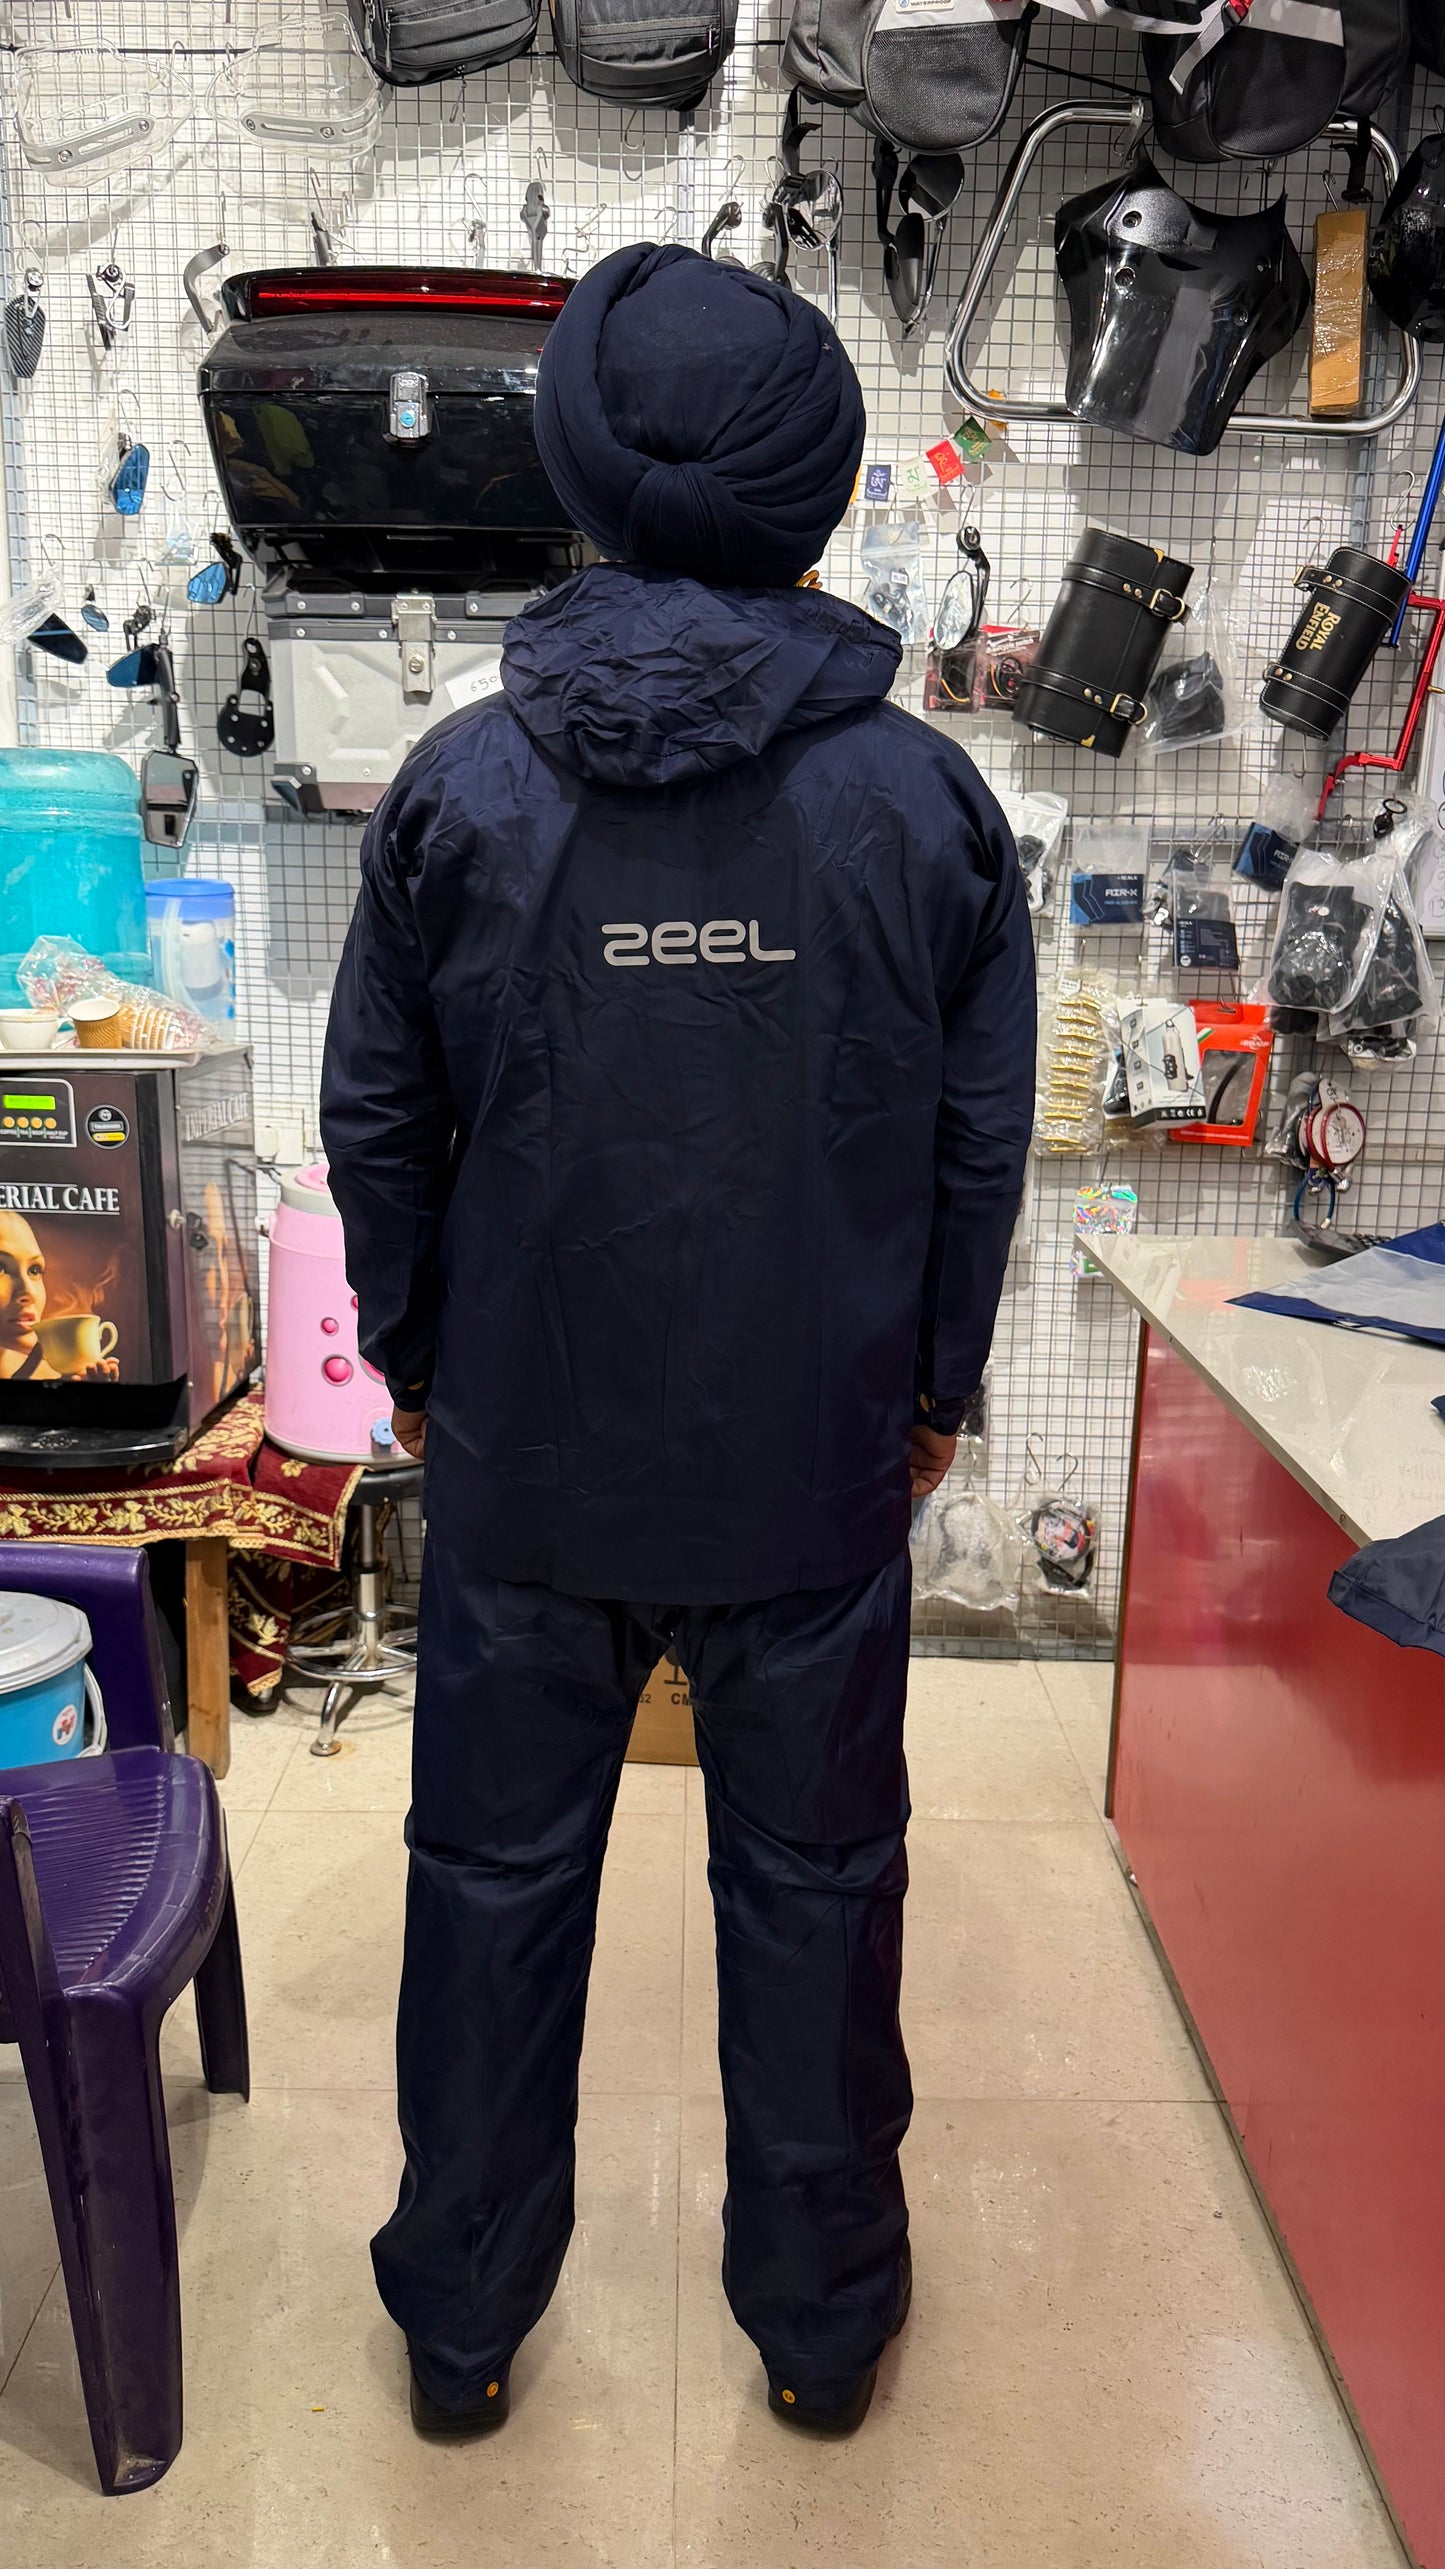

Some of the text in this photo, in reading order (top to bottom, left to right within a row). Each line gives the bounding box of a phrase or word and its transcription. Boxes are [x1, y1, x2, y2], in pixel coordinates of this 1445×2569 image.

[1295, 602, 1331, 651] ENFIELD
[1310, 612, 1342, 650] ROYAL
[62, 1186, 120, 1212] CAFE
